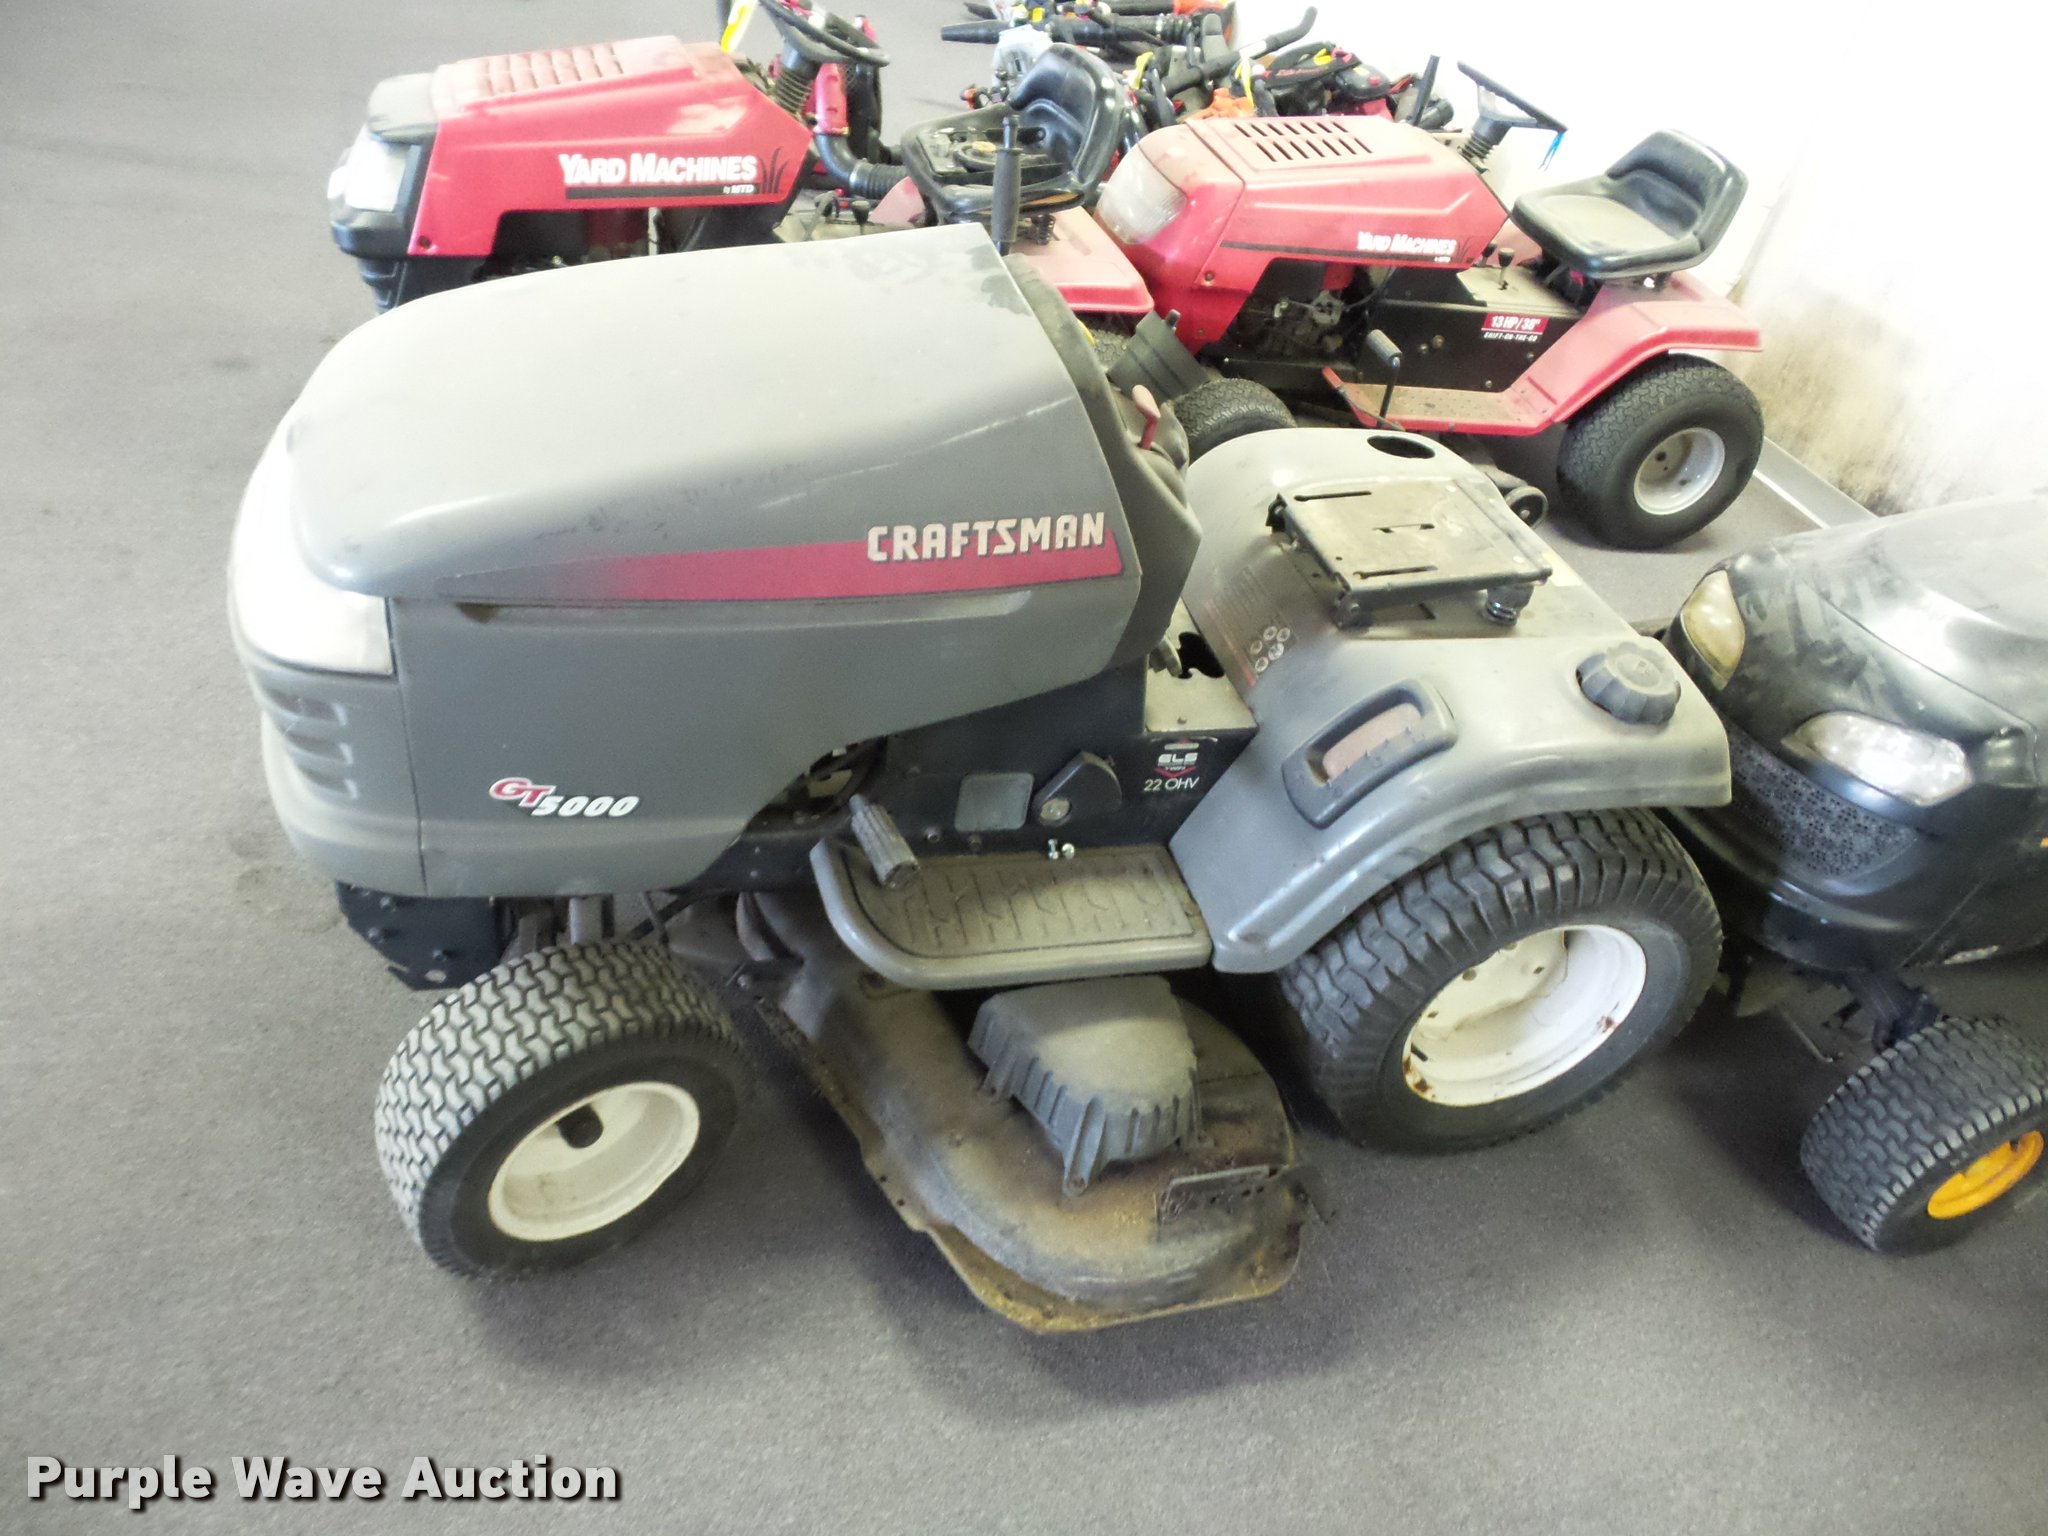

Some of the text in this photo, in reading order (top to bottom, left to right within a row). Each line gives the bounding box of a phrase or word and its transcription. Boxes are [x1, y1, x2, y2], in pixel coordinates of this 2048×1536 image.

[558, 153, 757, 184] YARD MACHINES
[731, 184, 754, 194] MTD
[867, 512, 1104, 562] CRAFTSMAN
[1144, 777, 1199, 791] 22 OHV
